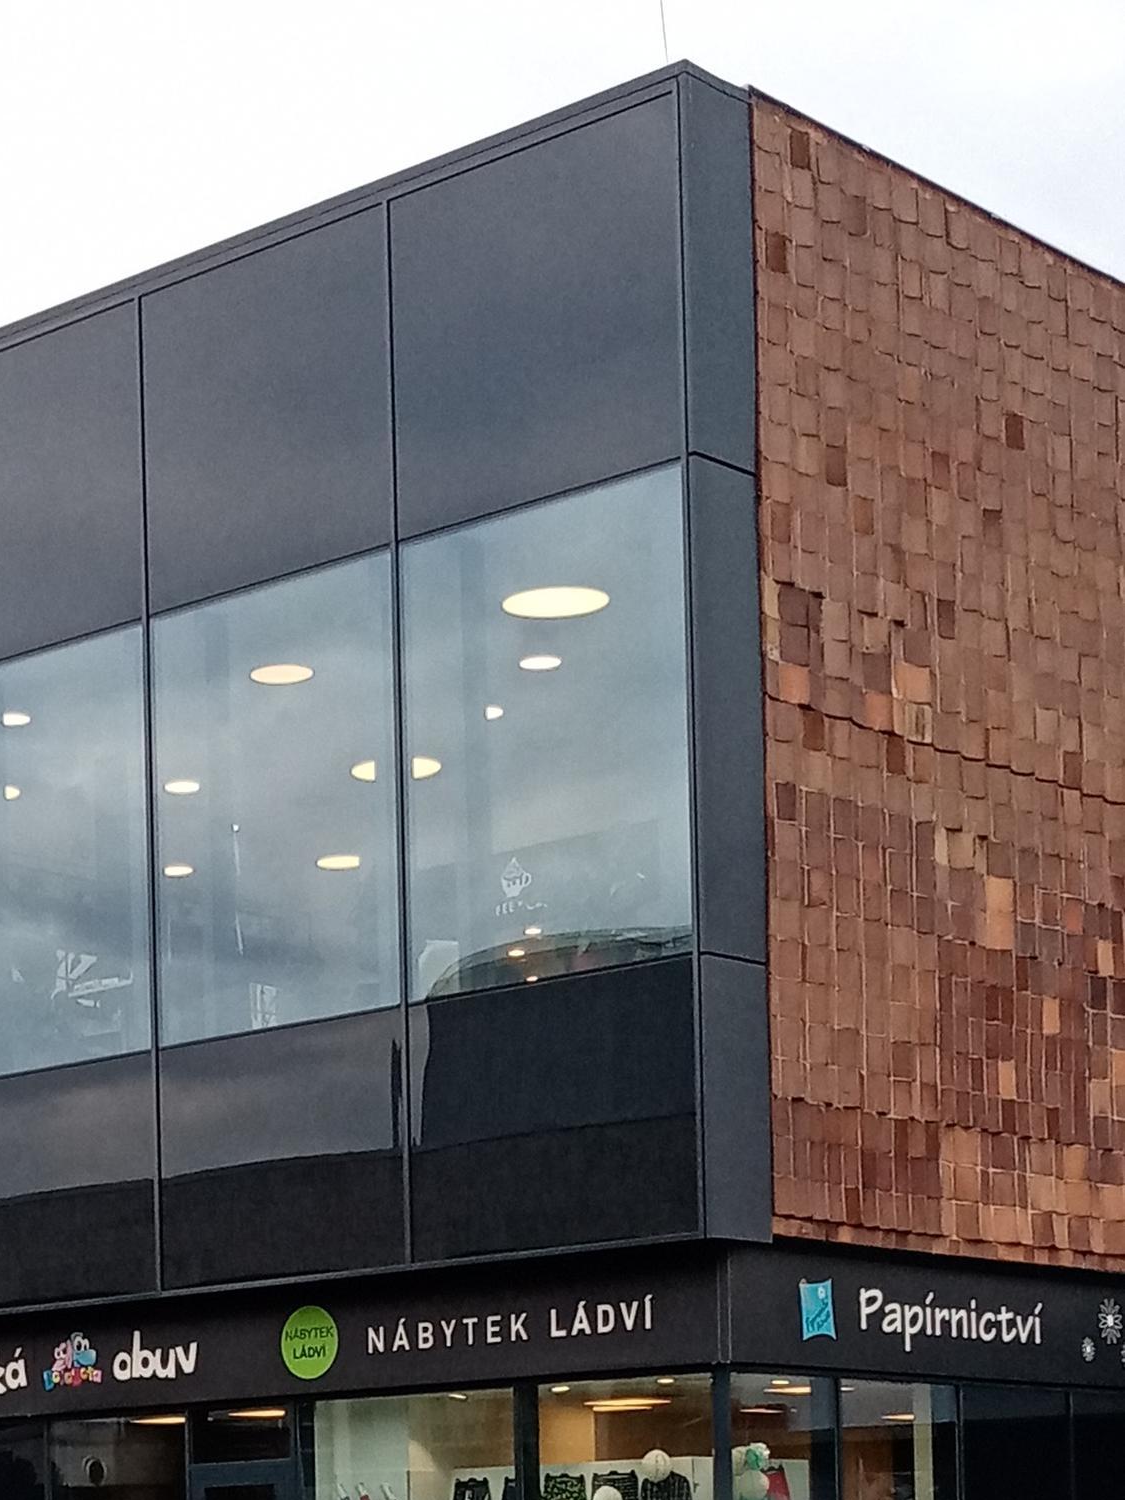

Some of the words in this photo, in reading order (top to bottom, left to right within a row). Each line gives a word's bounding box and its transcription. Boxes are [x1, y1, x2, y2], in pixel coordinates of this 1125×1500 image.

[367, 1312, 529, 1355] NÁBYTEK
[550, 1293, 655, 1338] LÁDVÍ
[859, 1288, 1043, 1353] Papírnictví
[112, 1330, 199, 1382] obuv
[293, 1343, 327, 1360] LÁDVÍ
